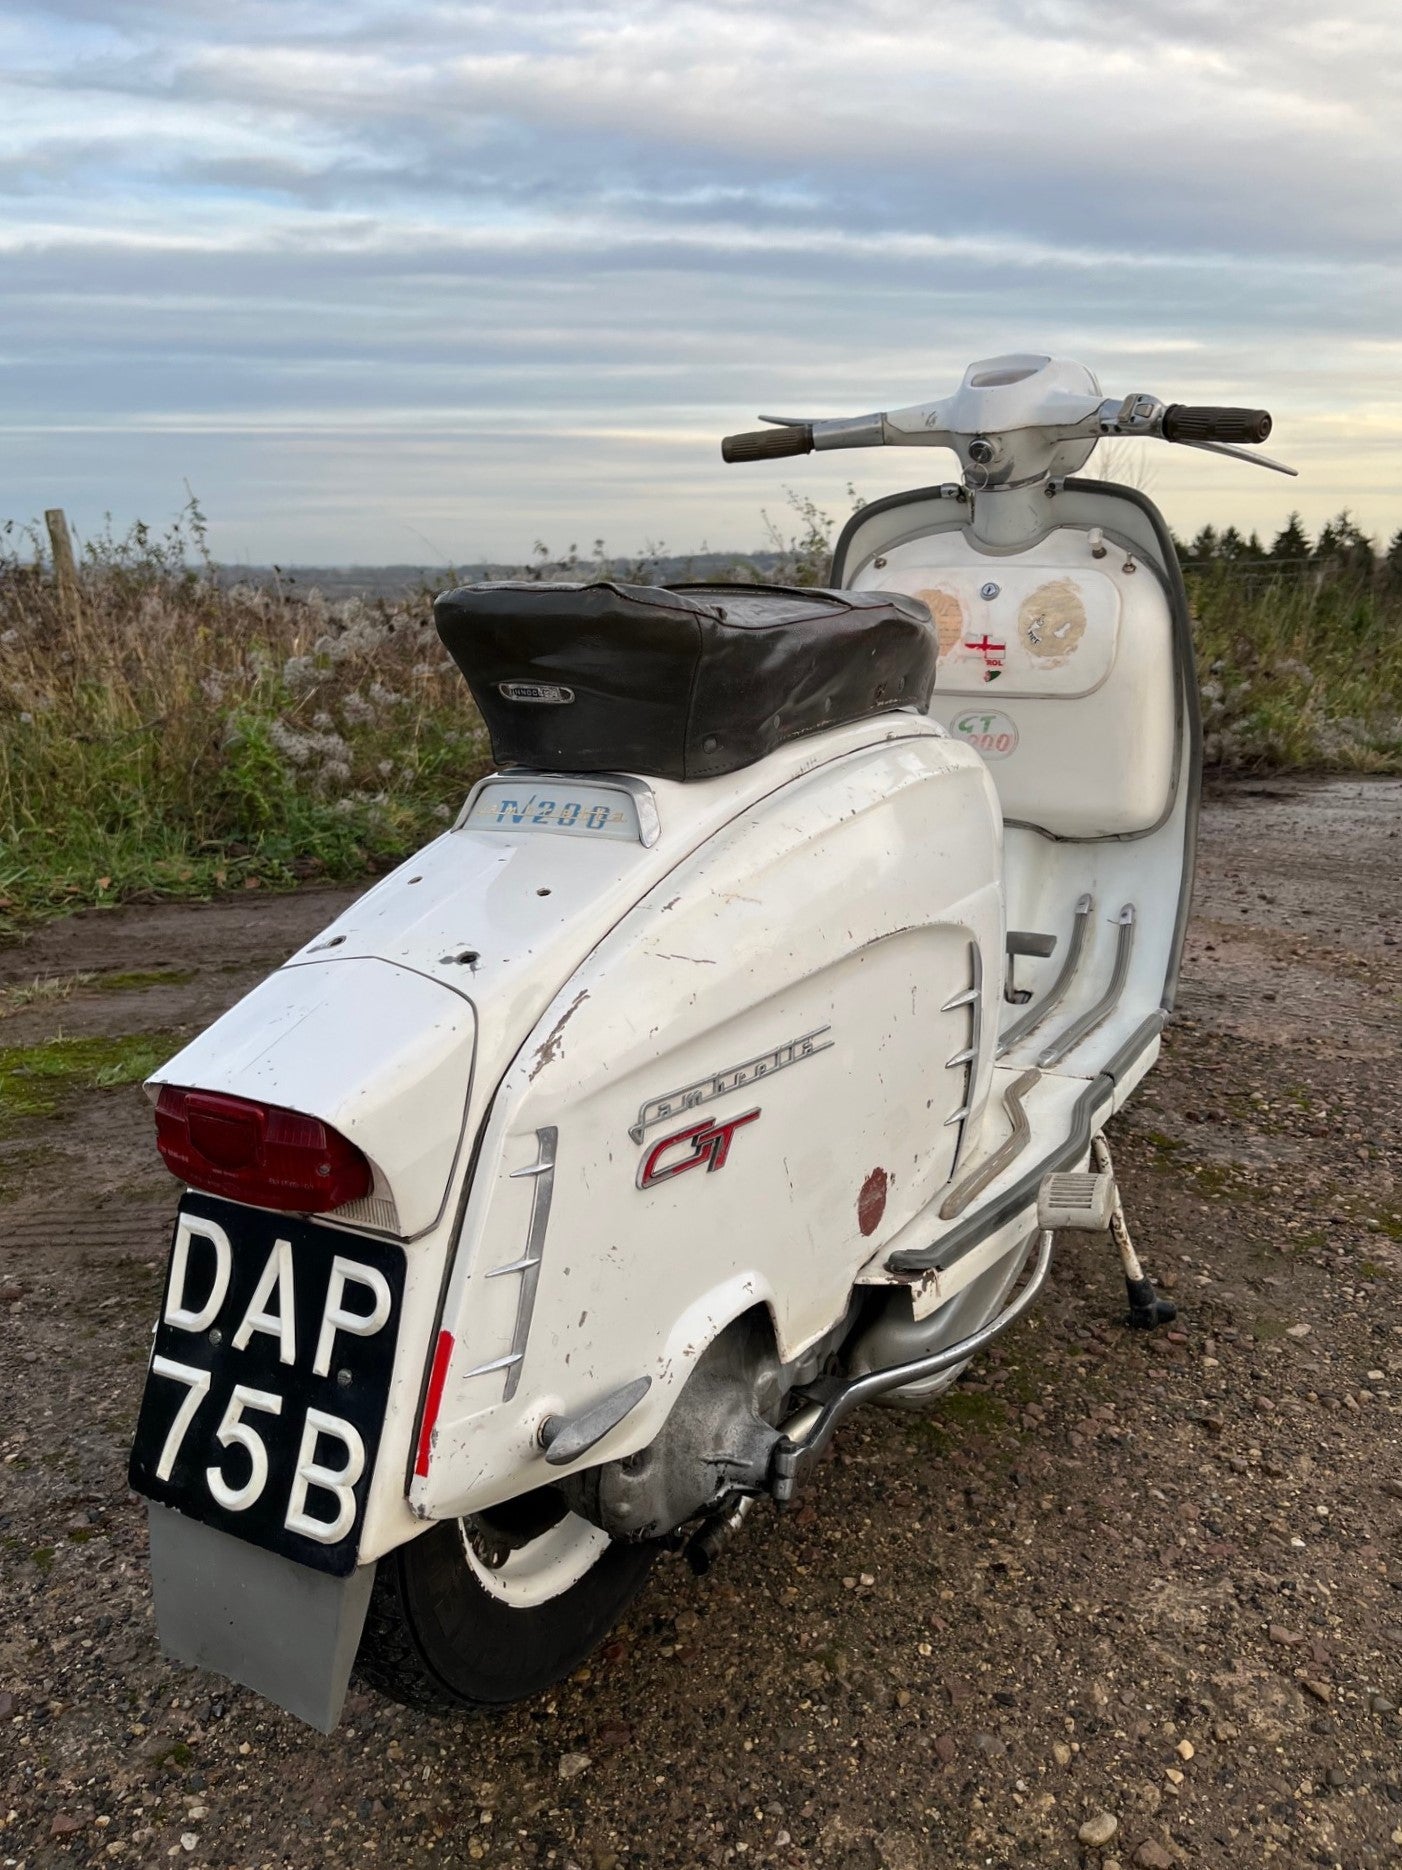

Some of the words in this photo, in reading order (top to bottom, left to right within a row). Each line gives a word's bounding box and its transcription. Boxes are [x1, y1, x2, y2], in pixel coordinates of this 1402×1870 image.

[958, 715, 997, 733] GT
[635, 1105, 762, 1190] GT
[164, 1212, 391, 1376] DAP
[152, 1355, 366, 1545] 75B
